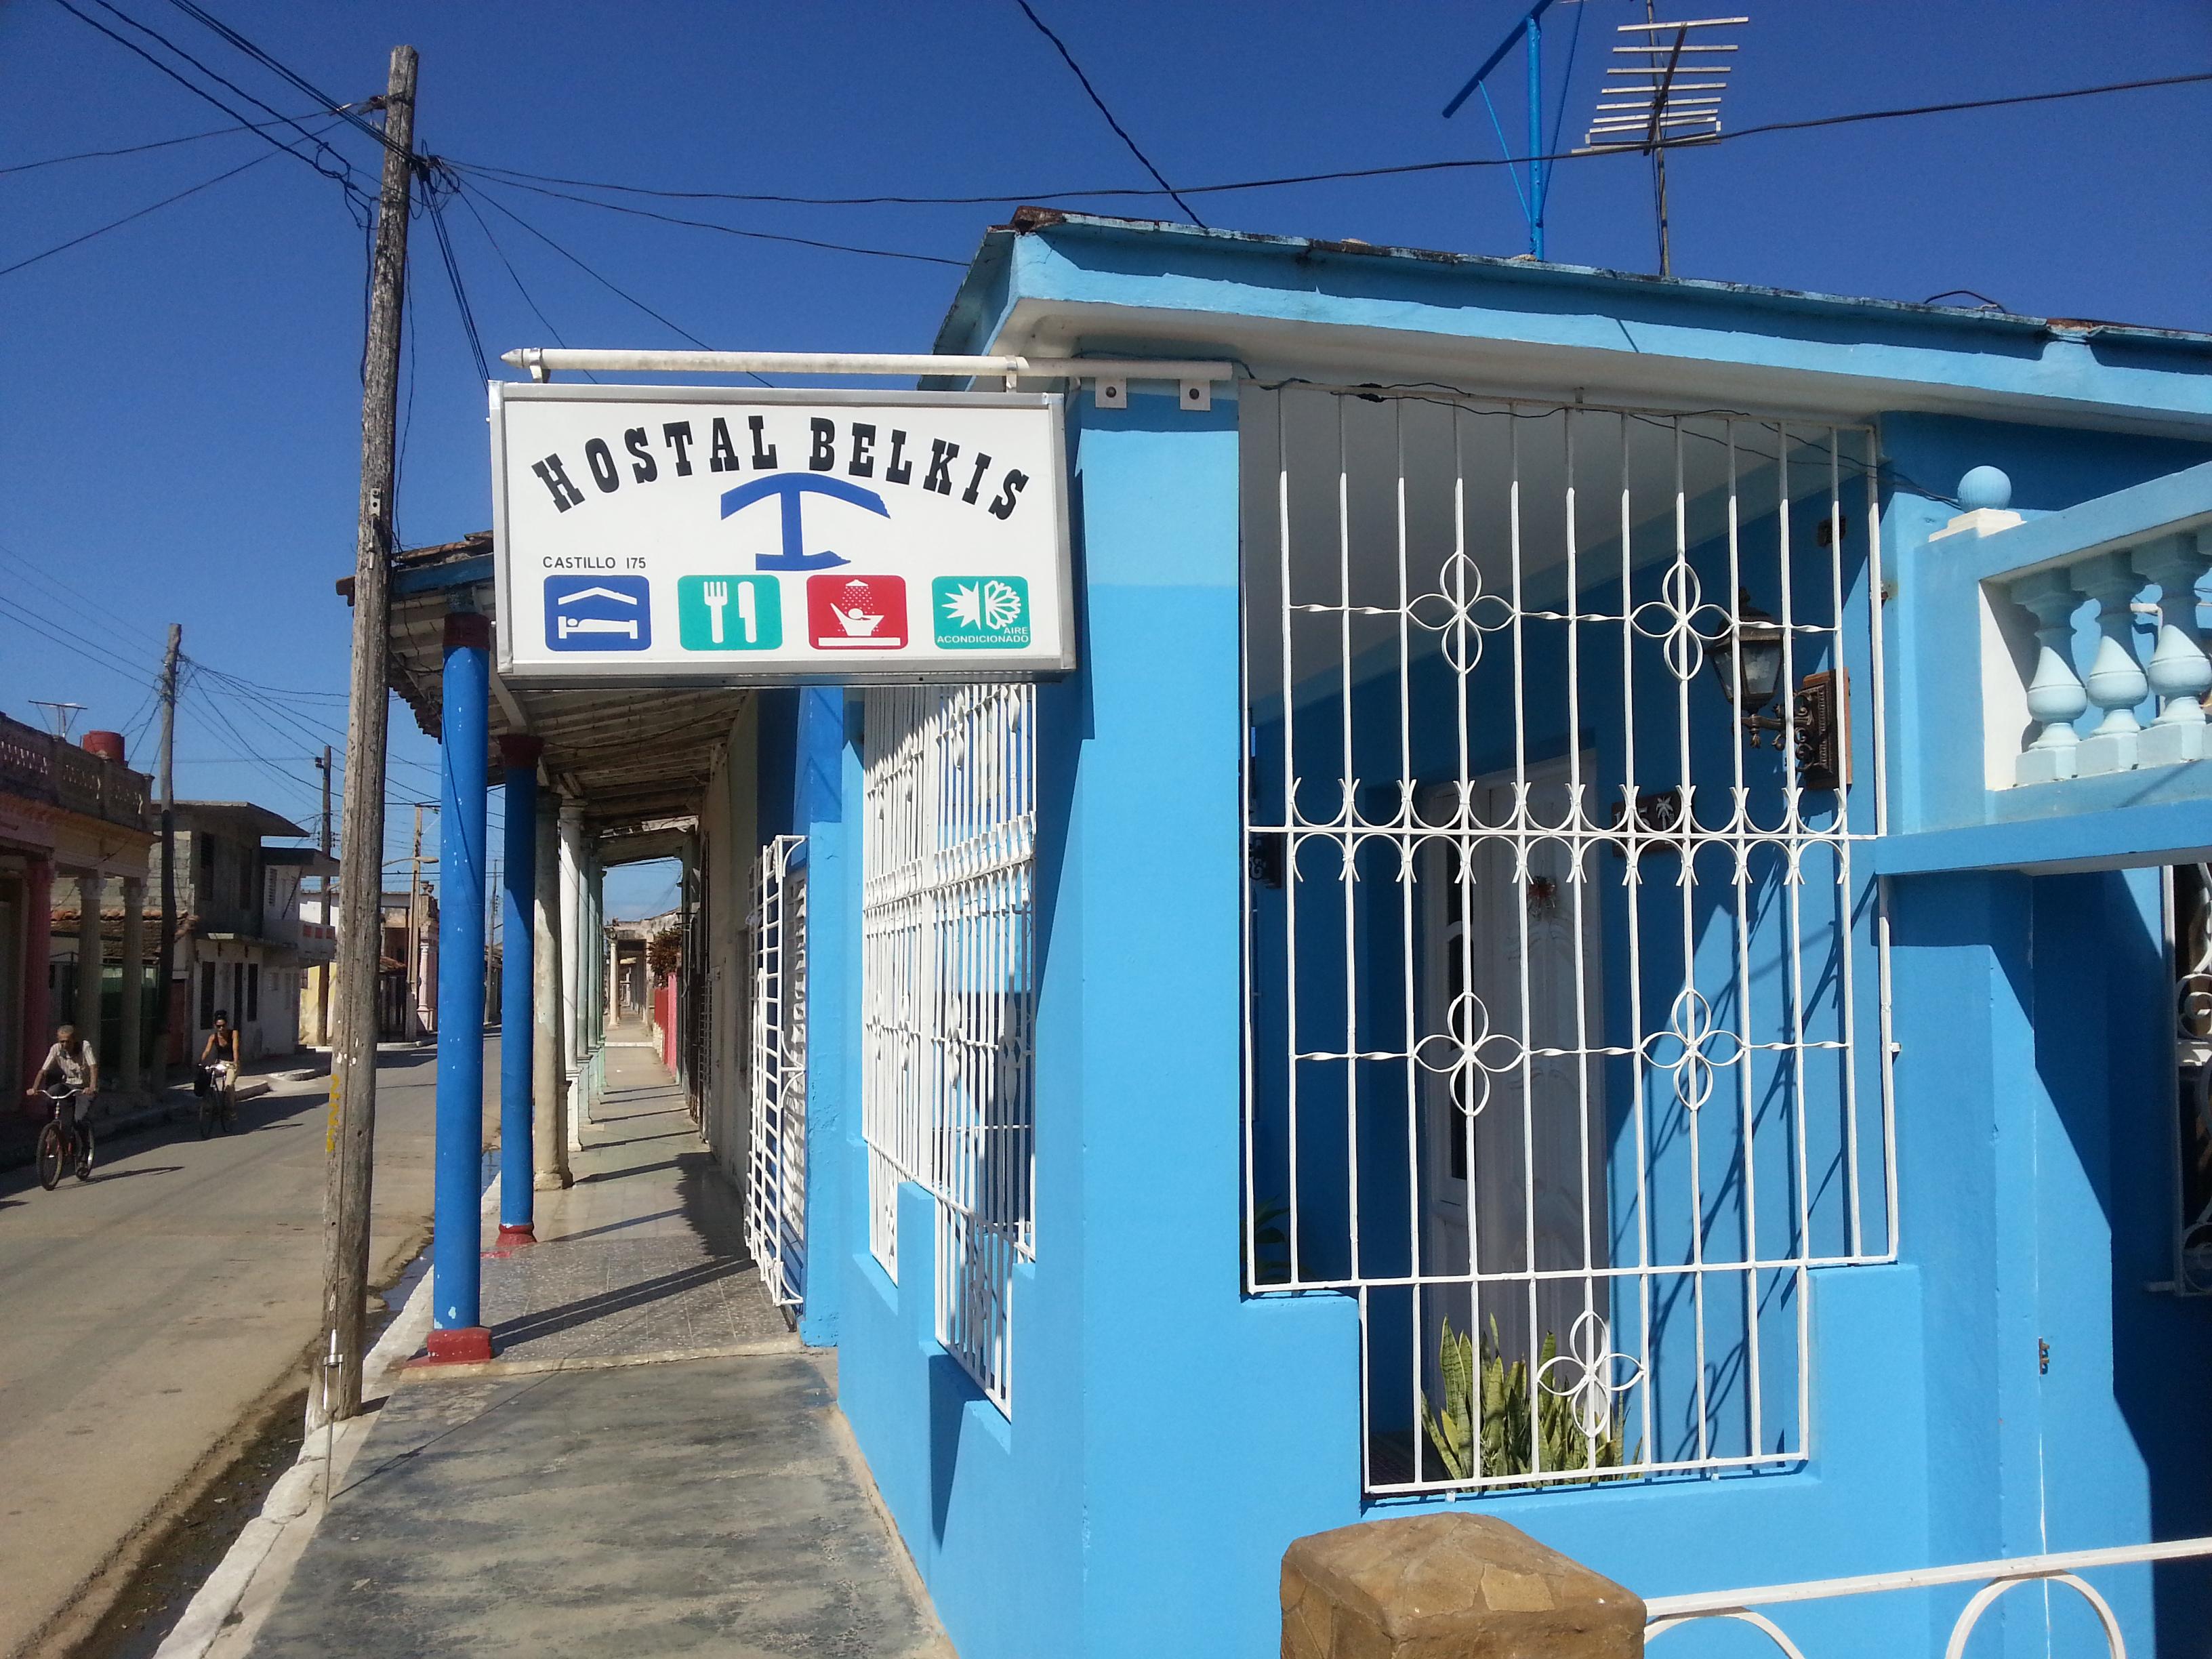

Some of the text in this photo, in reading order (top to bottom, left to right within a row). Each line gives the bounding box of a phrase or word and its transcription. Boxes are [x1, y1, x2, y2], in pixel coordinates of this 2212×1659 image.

[531, 415, 1030, 520] HOSTAL BELKIS
[543, 556, 646, 569] CASTILLO 175
[937, 635, 1029, 643] ACONDICIONADO
